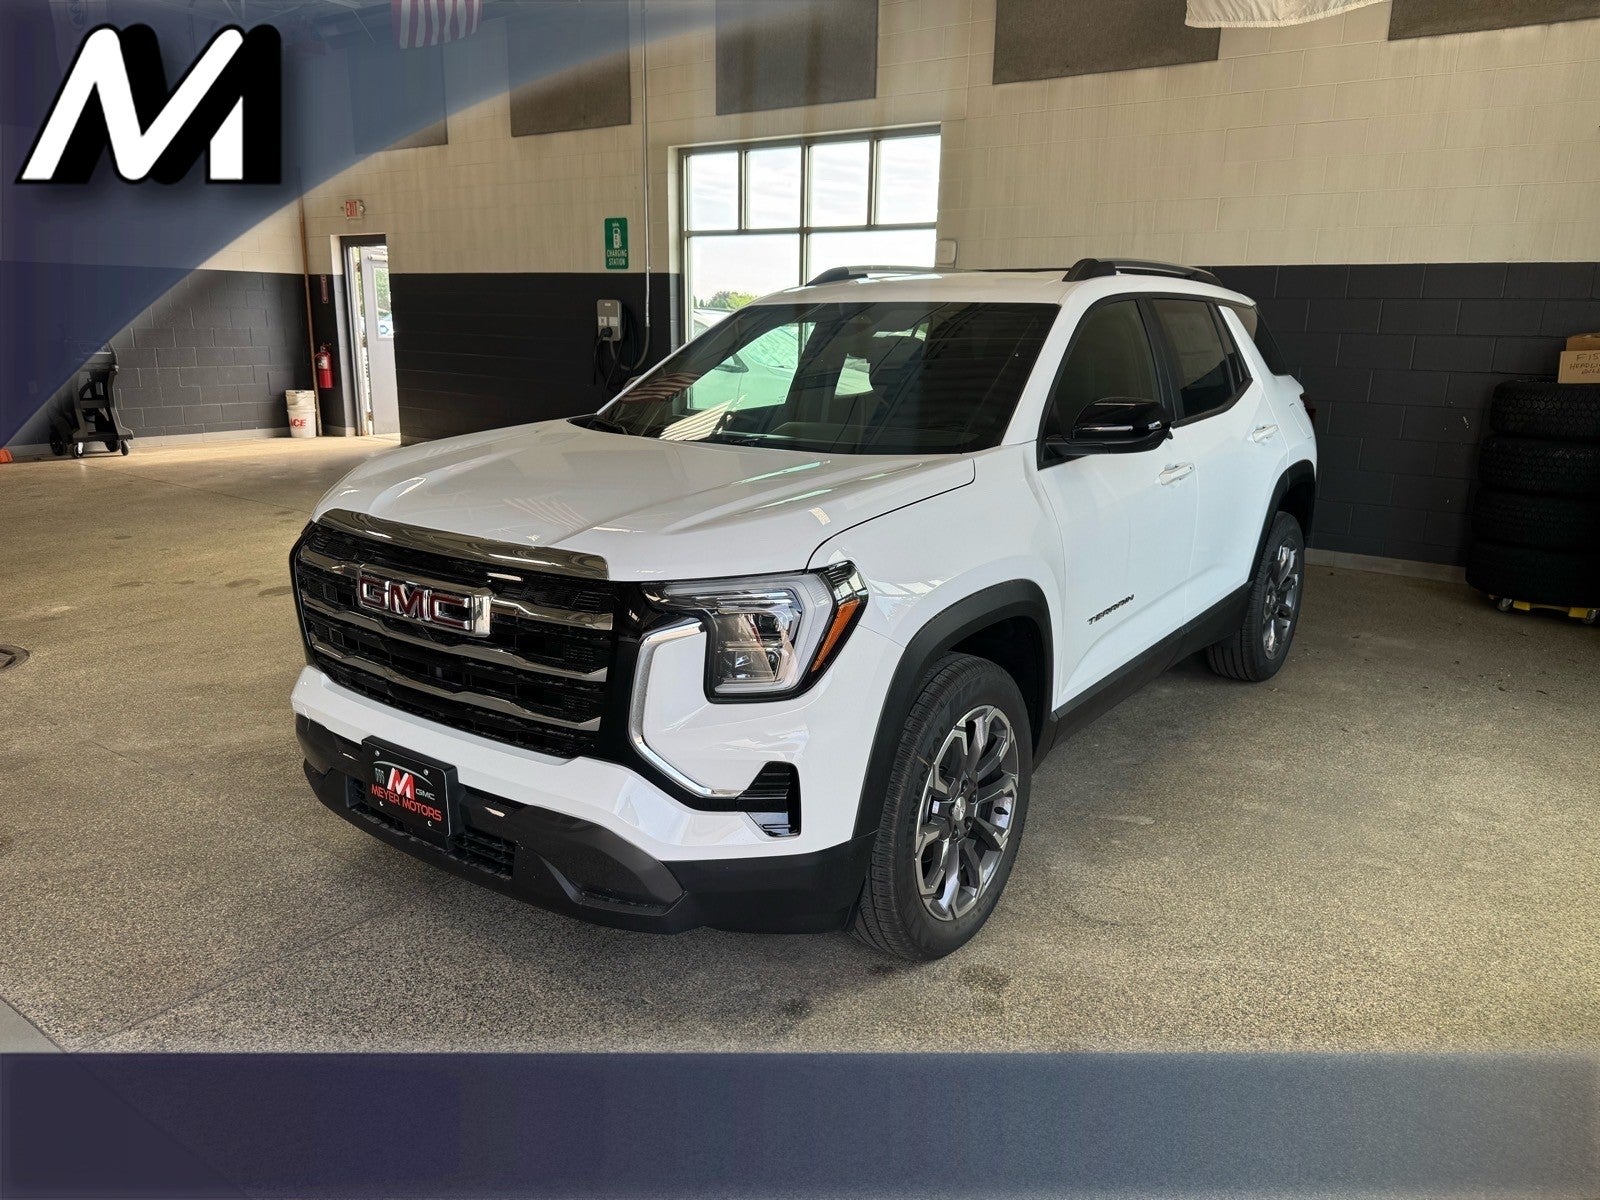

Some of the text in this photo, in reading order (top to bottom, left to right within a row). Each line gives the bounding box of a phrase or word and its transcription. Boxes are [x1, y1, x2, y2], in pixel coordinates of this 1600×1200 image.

[606, 249, 628, 258] CHARGING
[608, 258, 626, 266] STATION
[359, 576, 471, 631] GMC
[1087, 594, 1135, 625] TERRAIN
[371, 784, 442, 822] MEYER MOTORS
[415, 788, 436, 801] GMC
